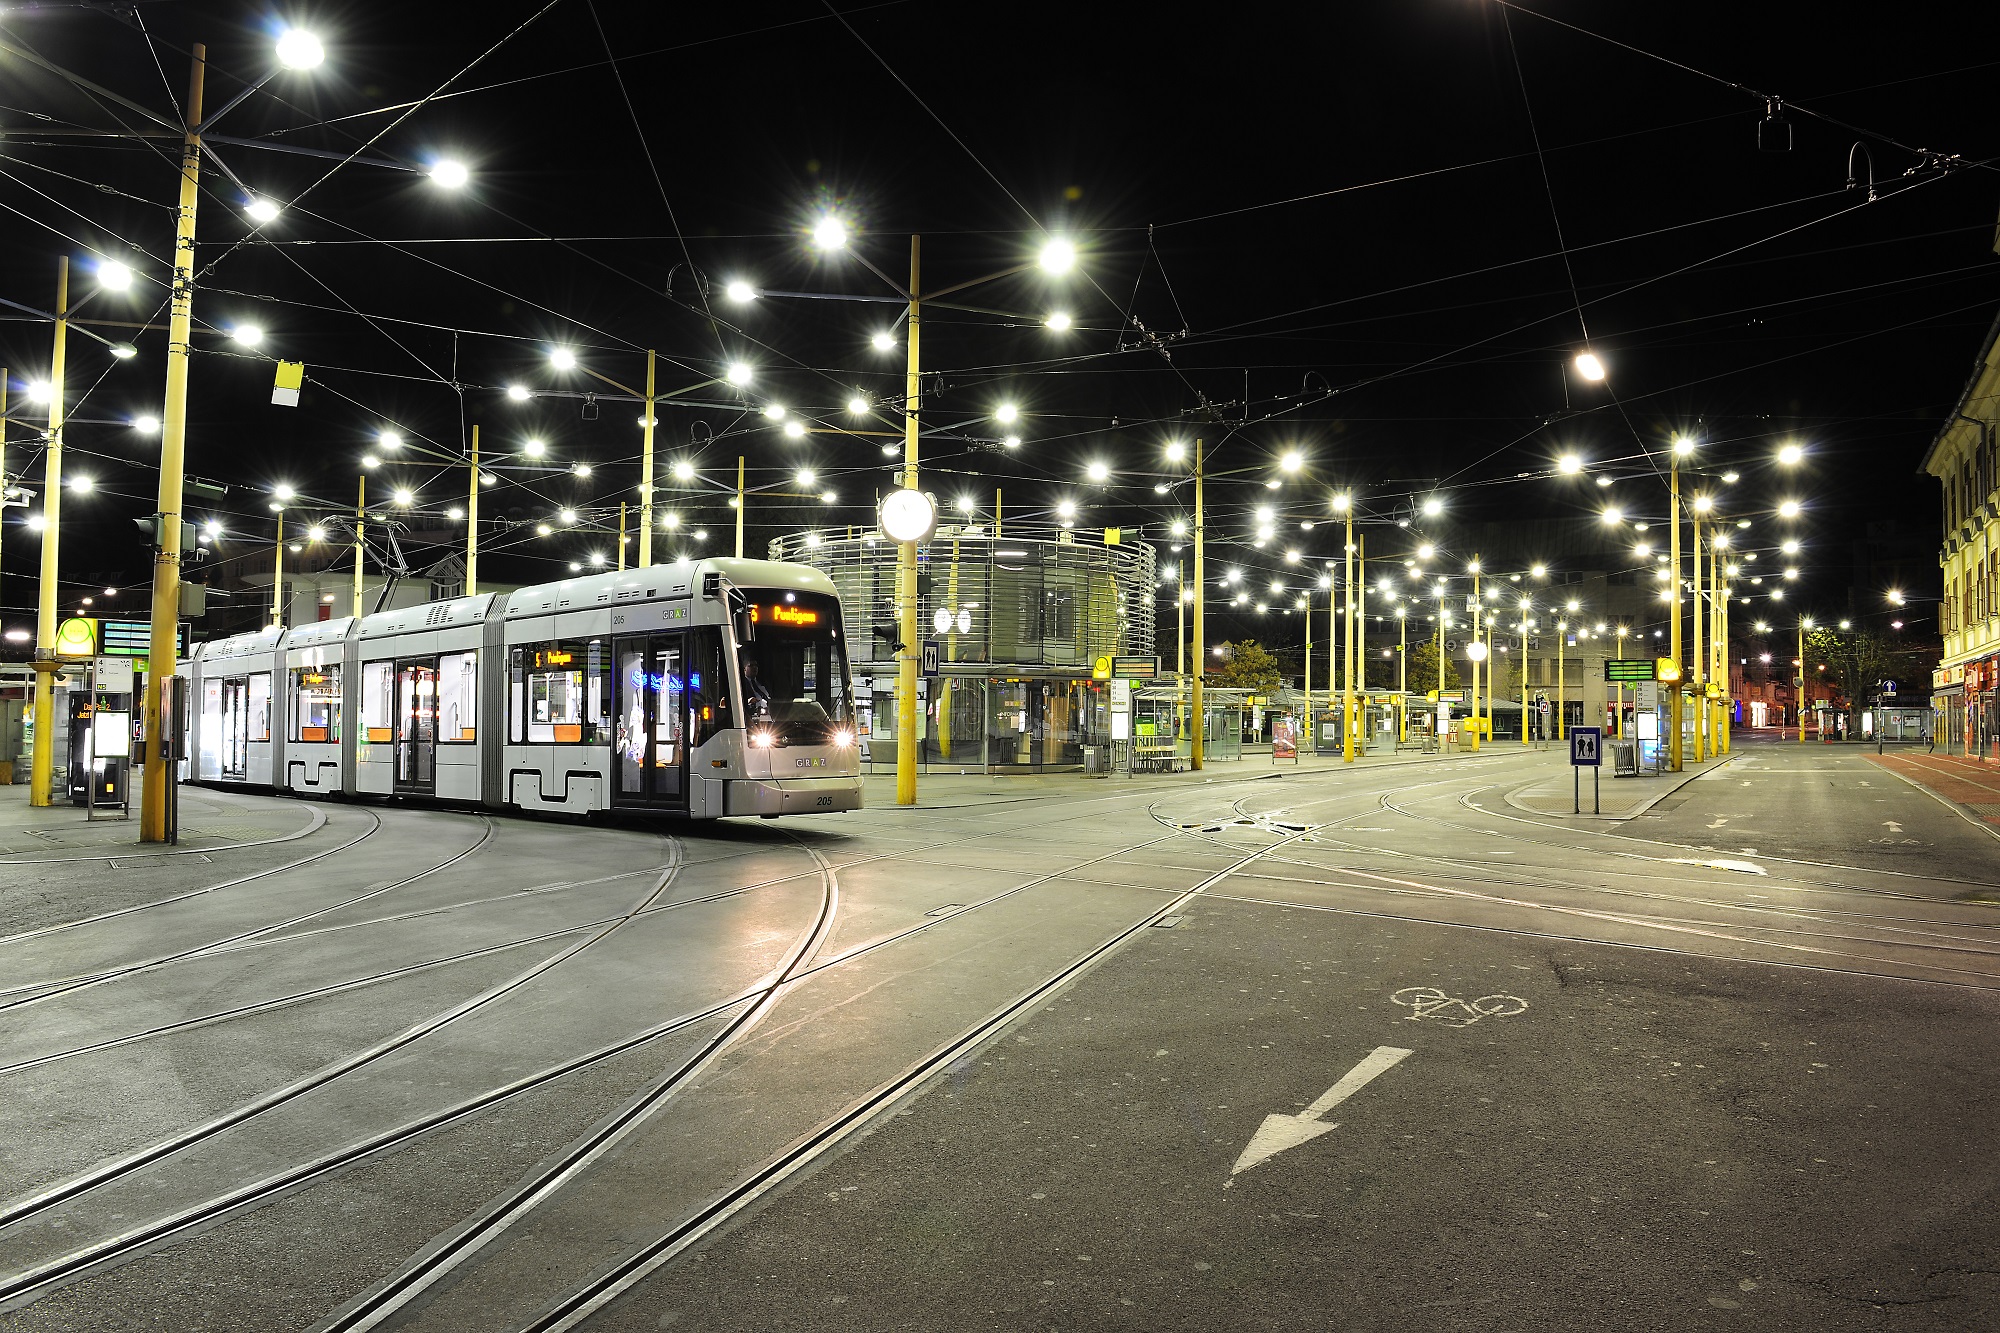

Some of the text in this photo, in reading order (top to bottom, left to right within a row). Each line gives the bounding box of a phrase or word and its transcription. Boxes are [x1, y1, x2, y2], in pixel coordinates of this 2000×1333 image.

[663, 608, 687, 619] GRAZ
[613, 615, 625, 624] 205
[138, 660, 145, 669] E
[703, 706, 709, 720] 5
[796, 758, 826, 767] GRAZ
[816, 796, 833, 806] 205
